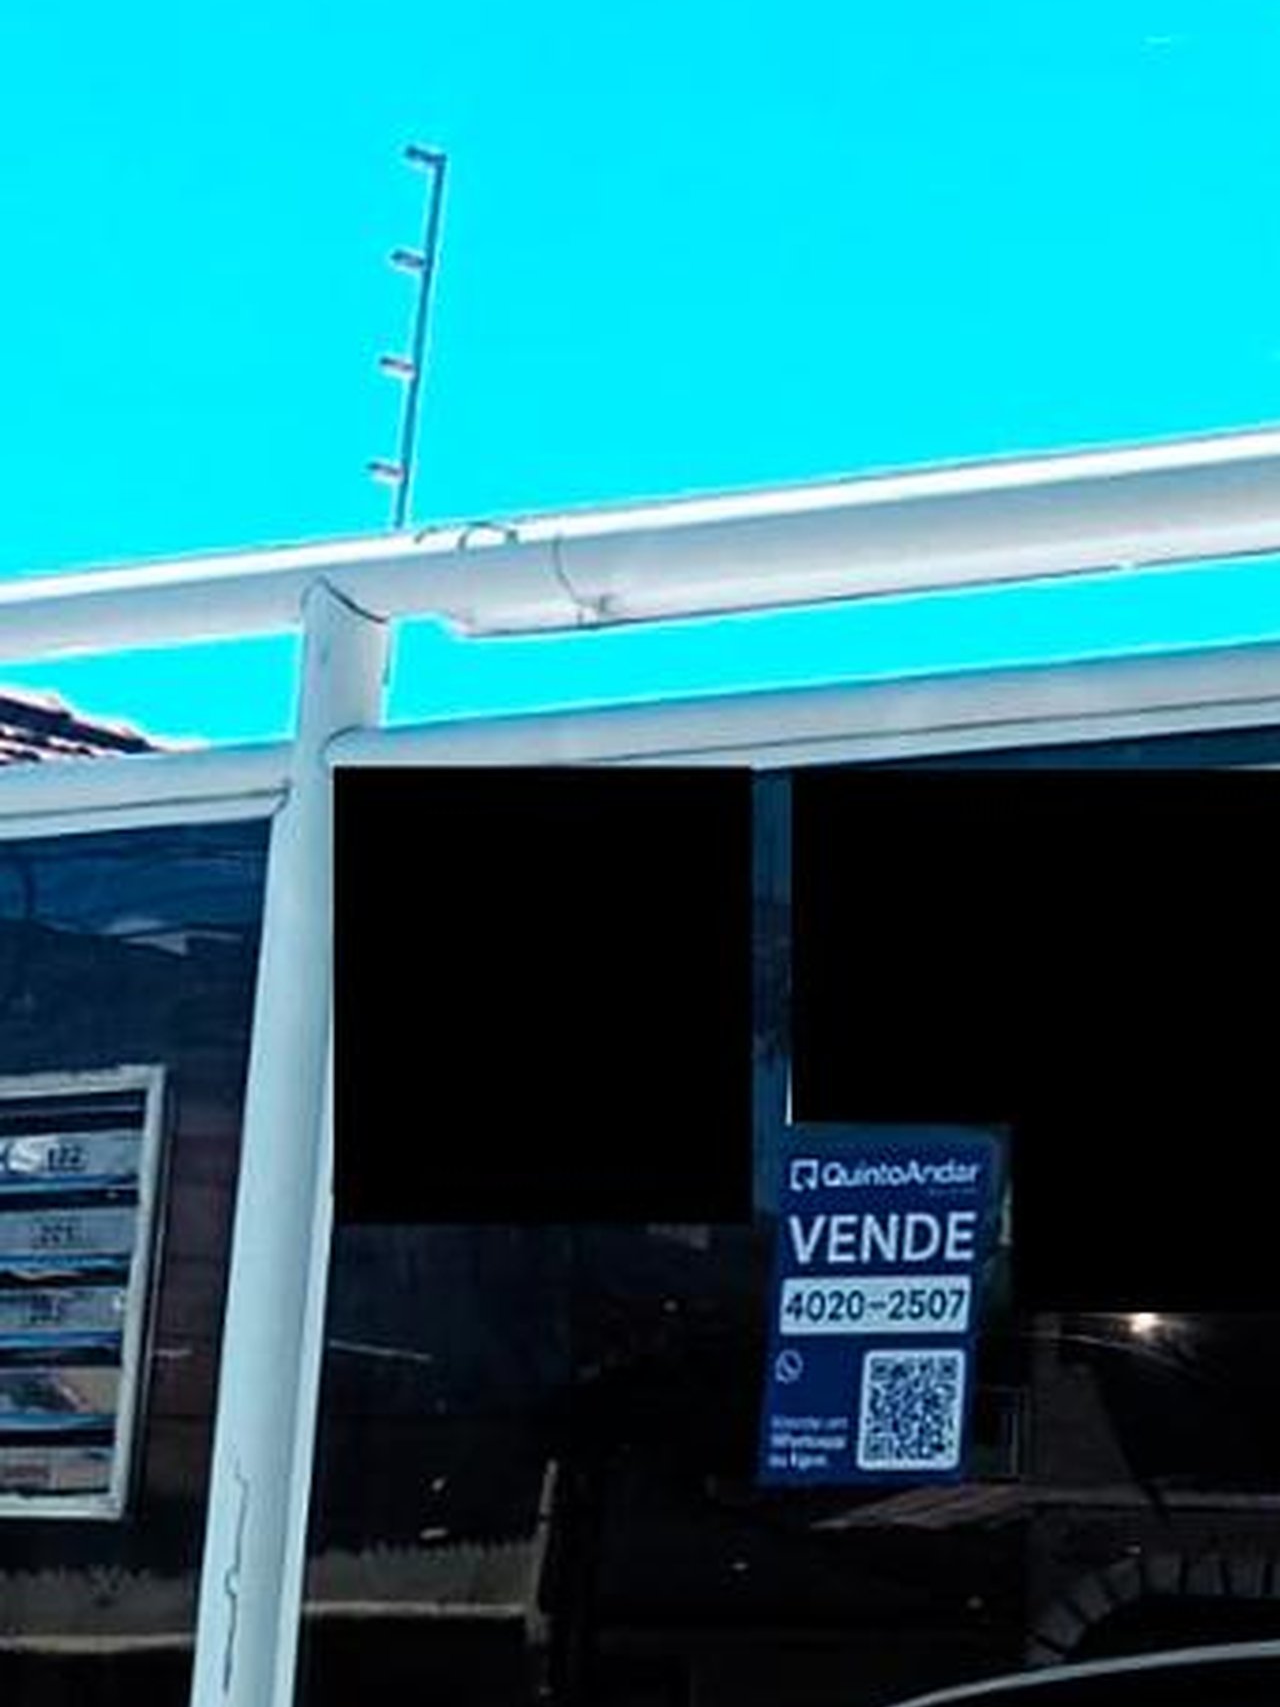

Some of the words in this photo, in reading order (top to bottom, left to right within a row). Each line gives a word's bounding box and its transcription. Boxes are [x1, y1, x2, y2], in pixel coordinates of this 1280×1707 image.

[822, 1158, 980, 1188] QuintoAndar
[788, 1211, 978, 1265] VENDE
[784, 1288, 966, 1323] 4020-2507
